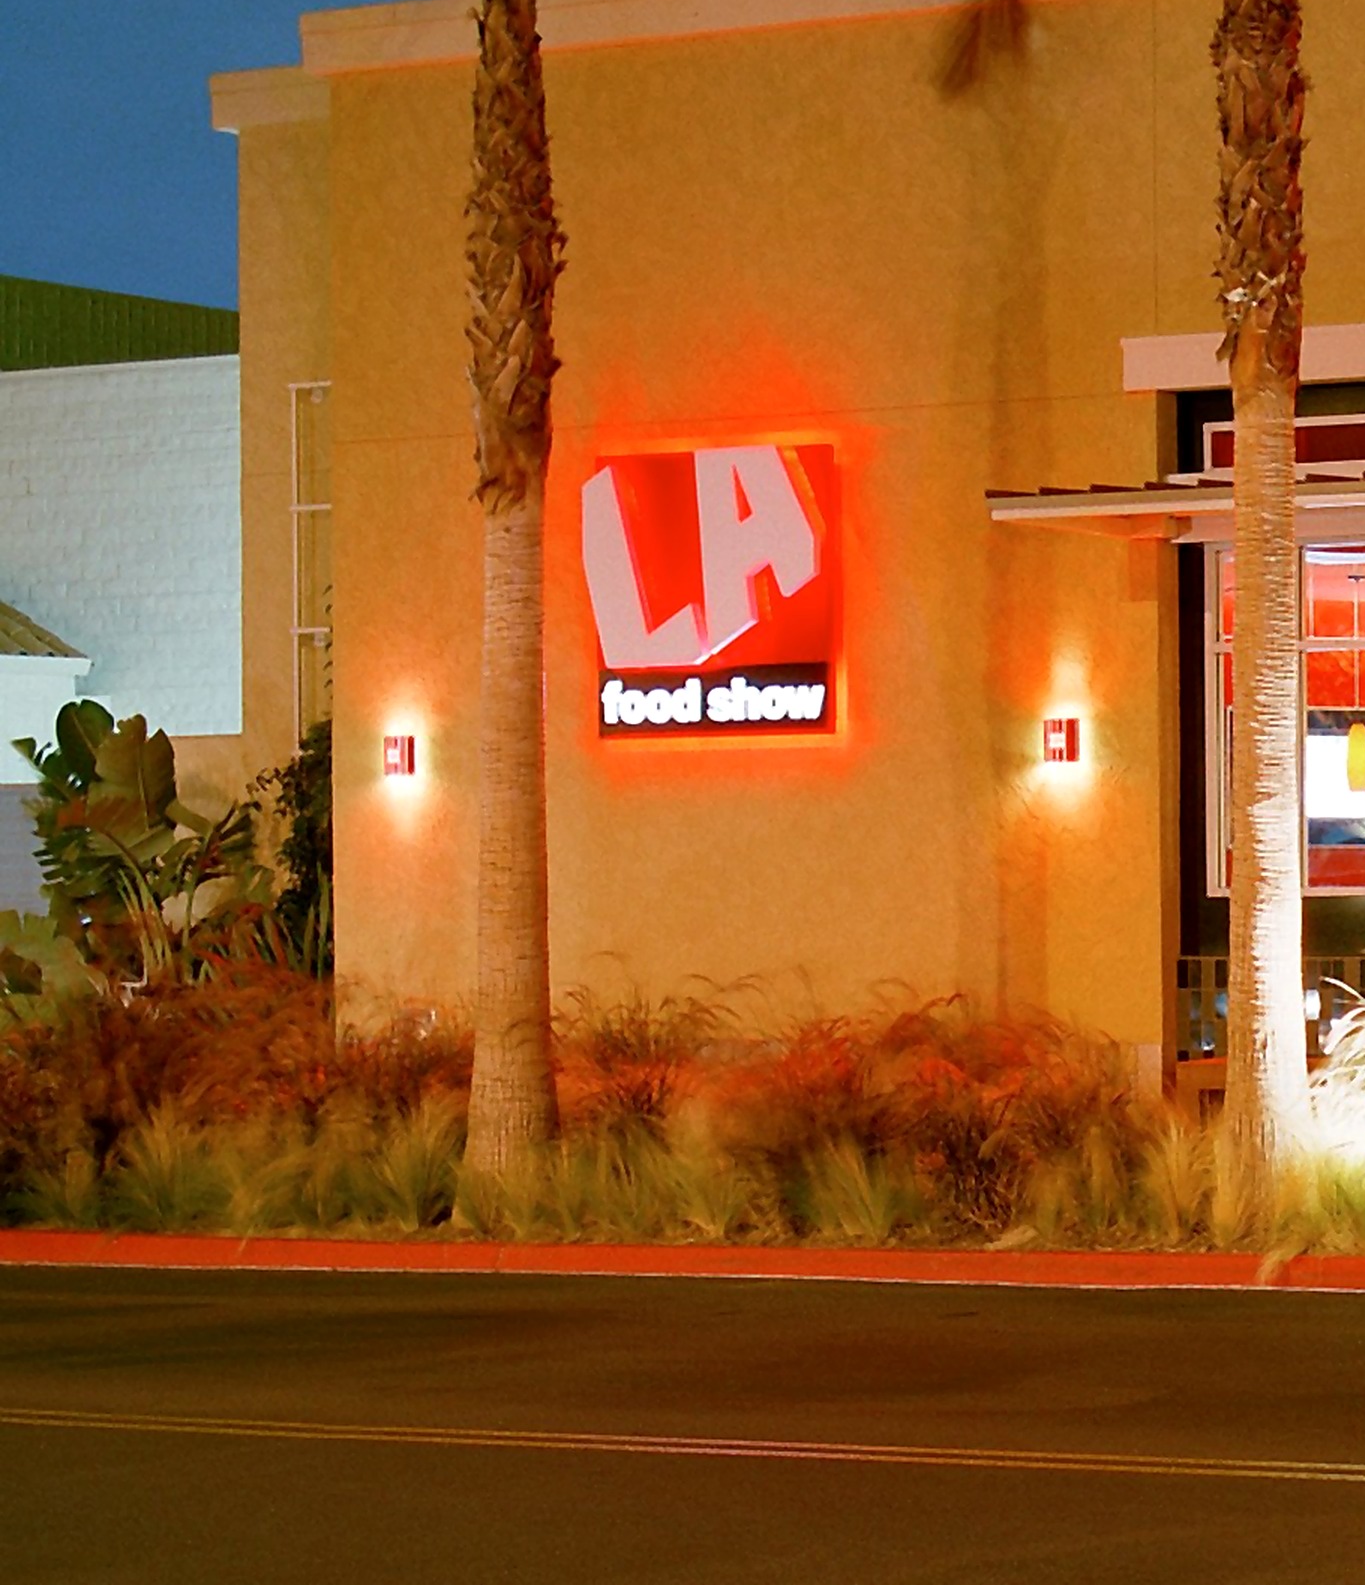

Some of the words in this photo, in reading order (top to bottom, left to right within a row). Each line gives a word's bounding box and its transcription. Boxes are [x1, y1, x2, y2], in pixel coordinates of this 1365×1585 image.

[581, 444, 819, 669] LA
[601, 677, 702, 725] food
[706, 676, 826, 722] show
